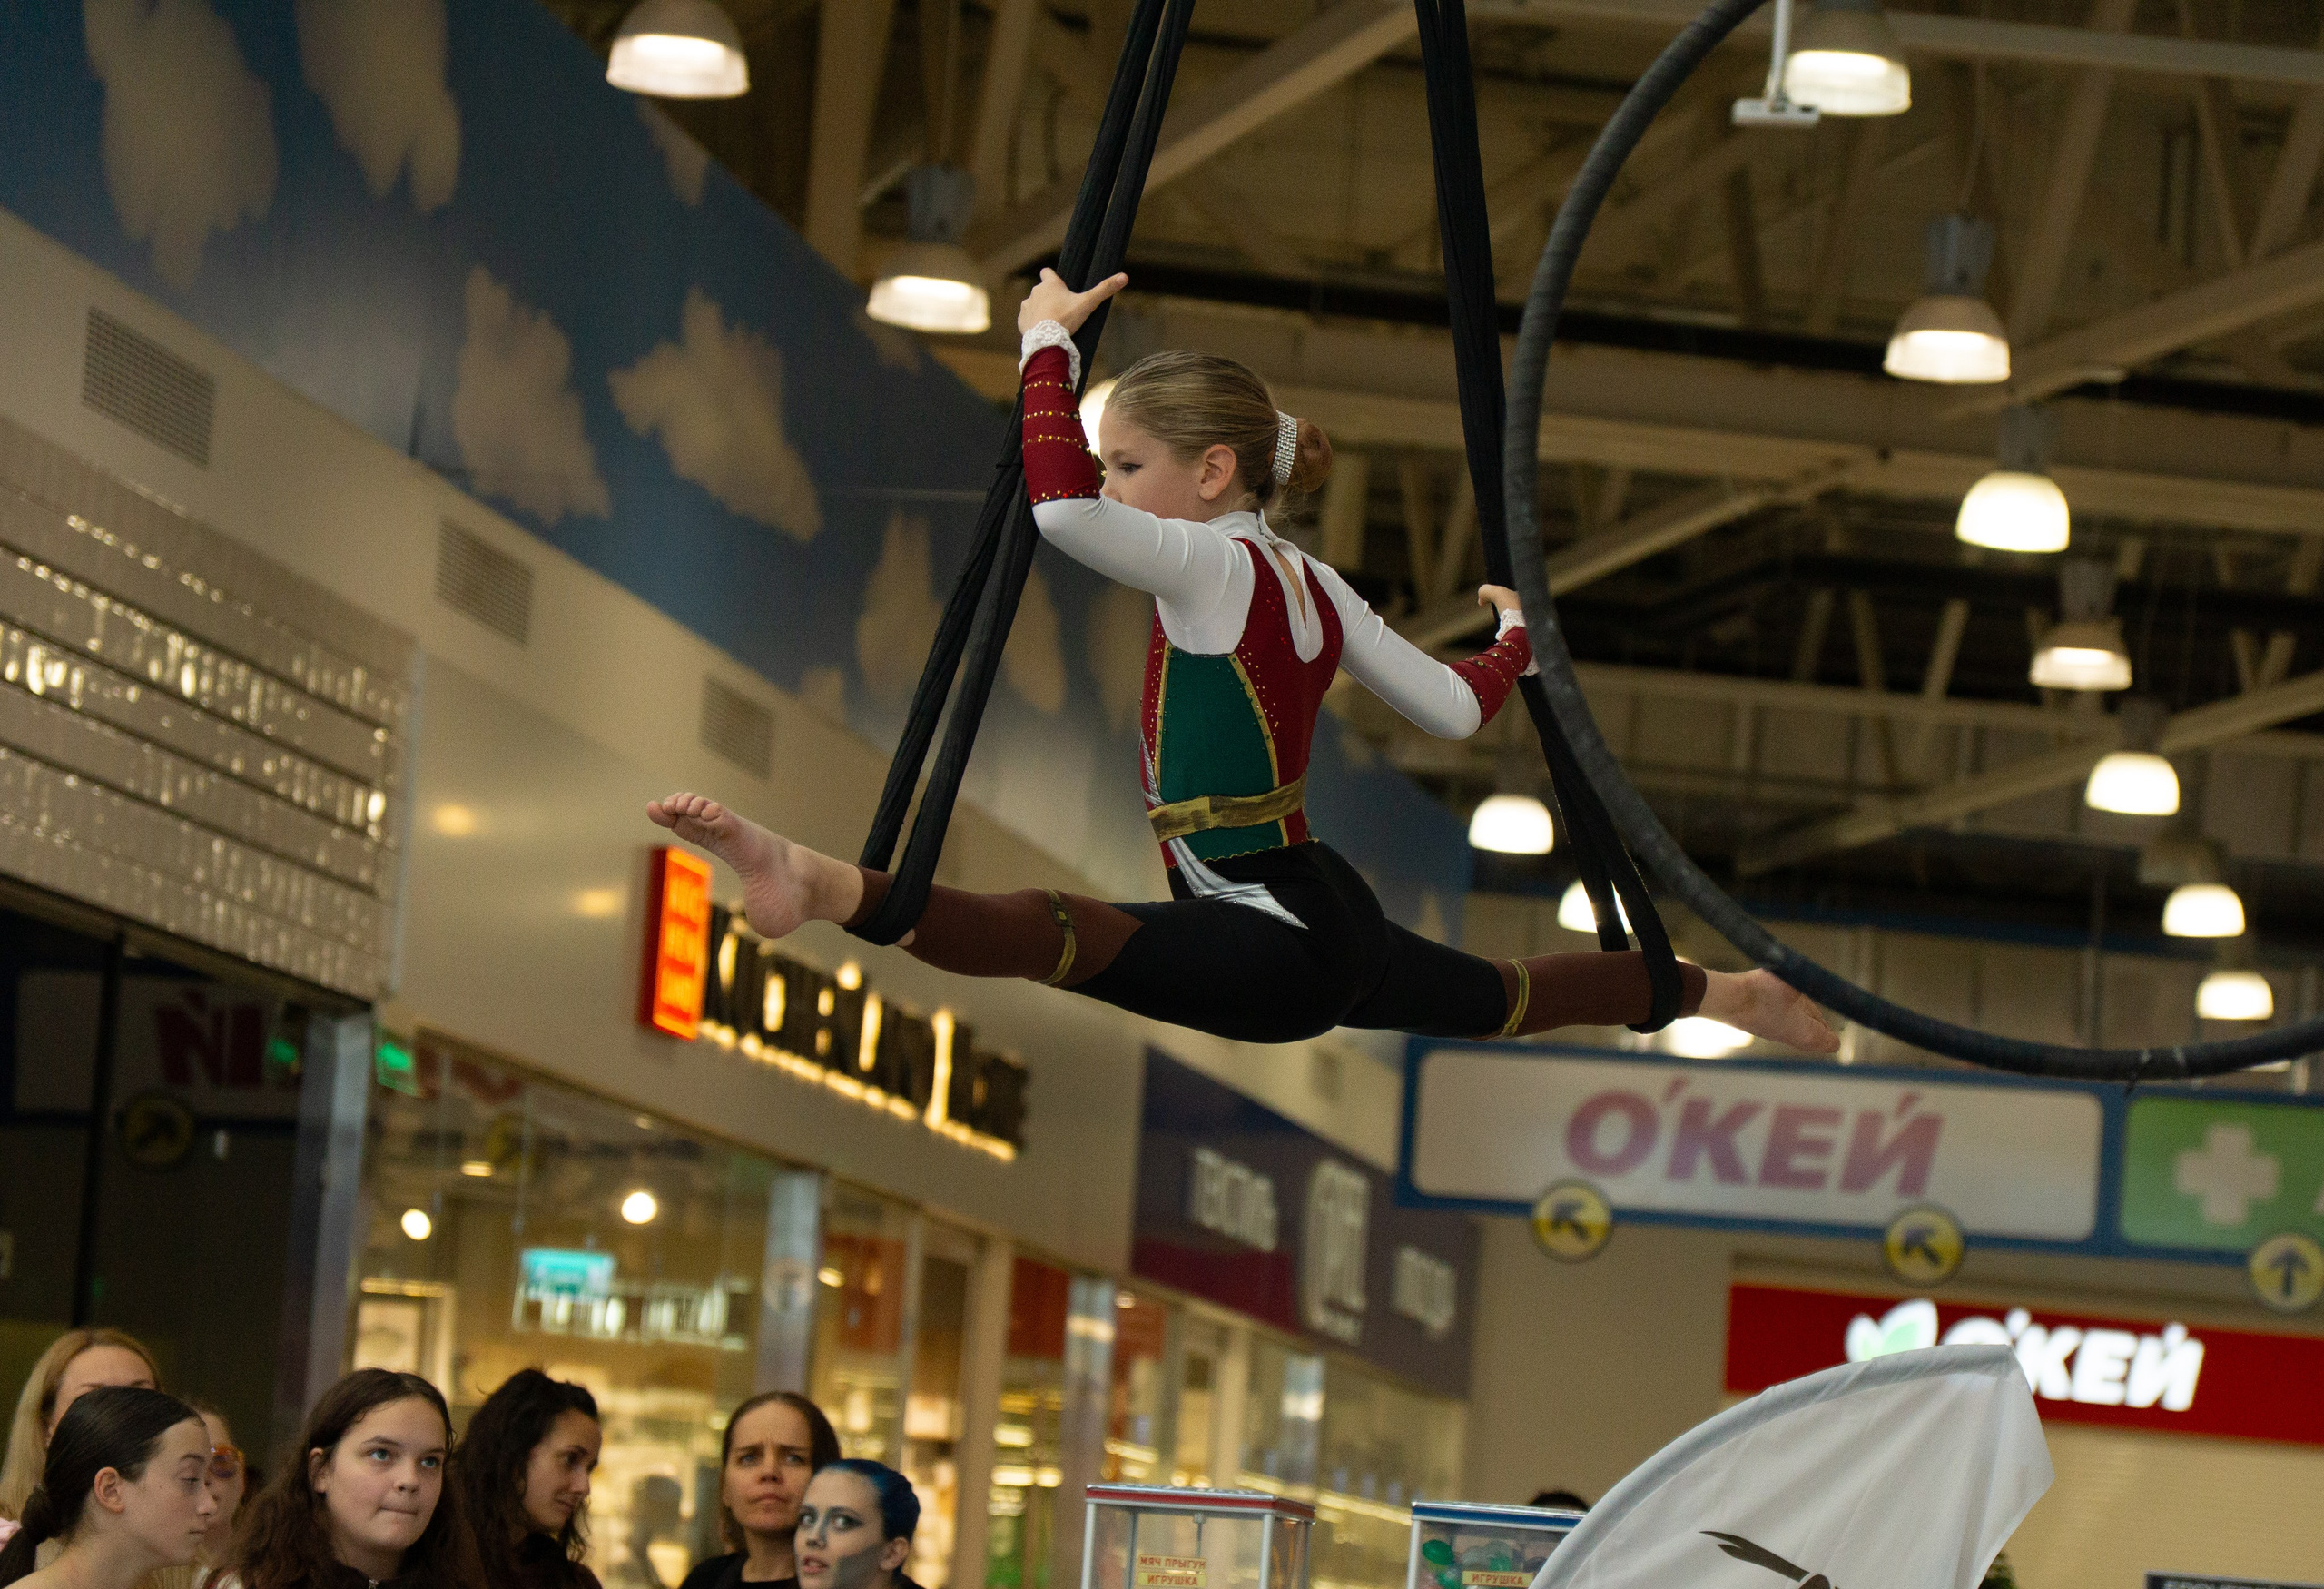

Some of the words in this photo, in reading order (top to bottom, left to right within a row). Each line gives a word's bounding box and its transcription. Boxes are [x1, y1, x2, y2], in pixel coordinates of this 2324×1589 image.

[1565, 1075, 1946, 1199] О'КЕЙ
[1140, 1556, 1161, 1566] МЯЧ
[1165, 1558, 1206, 1569] ПРЫГУН
[1147, 1574, 1198, 1585] ИГРУШКА
[1472, 1574, 1524, 1584] ИГРУШКА
